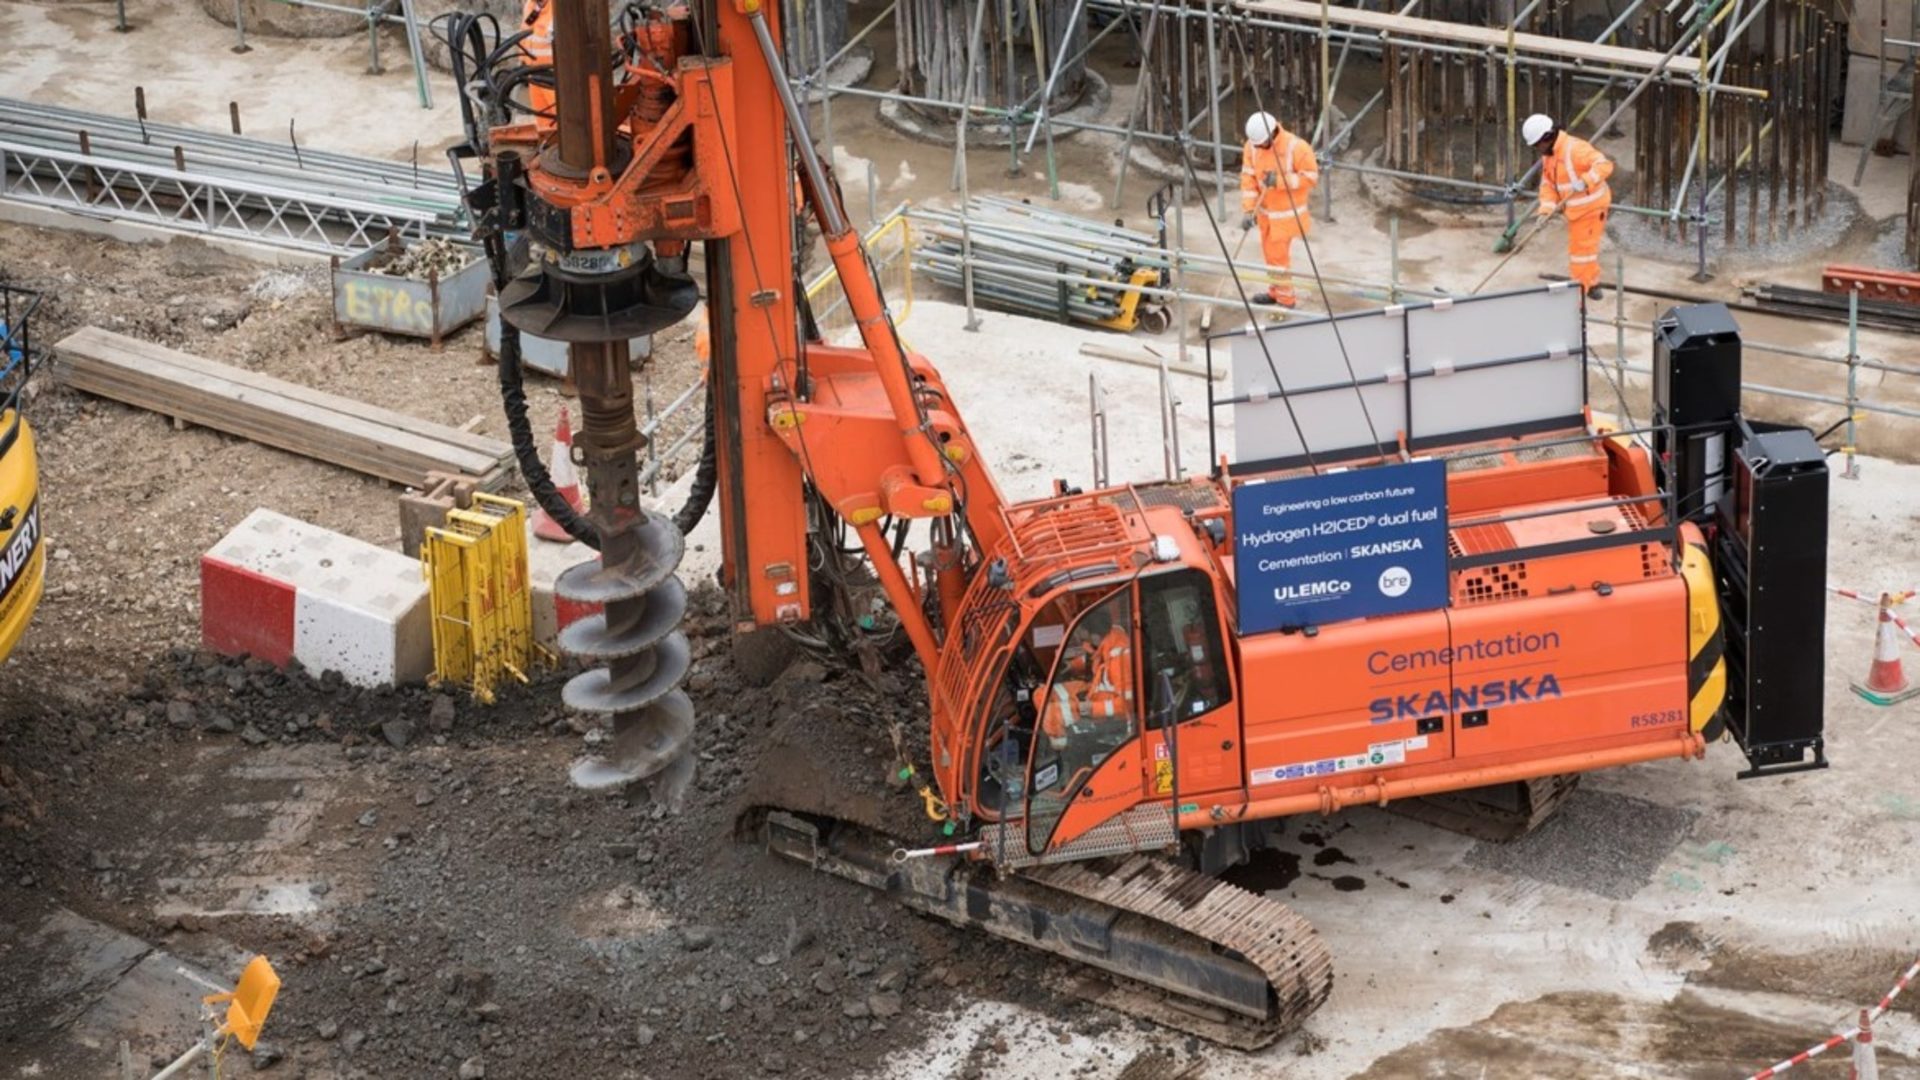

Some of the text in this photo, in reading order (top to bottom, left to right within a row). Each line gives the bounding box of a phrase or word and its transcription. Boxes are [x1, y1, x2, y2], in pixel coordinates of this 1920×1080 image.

[1263, 499, 1321, 515] Engineering
[1330, 496, 1348, 505] low
[1349, 490, 1384, 503] carbon
[1385, 486, 1415, 497] future
[1242, 527, 1311, 547] Hydrogen
[1378, 510, 1409, 527] dual
[1411, 507, 1438, 521] fuel
[0, 504, 37, 594] NERY
[1258, 538, 1423, 572] Cementation SKANSKA
[1274, 573, 1408, 600] ULEMCo bre
[1367, 631, 1560, 675] Cementation
[1369, 674, 1561, 724] SKANSKA
[1631, 710, 1683, 728] R58281
